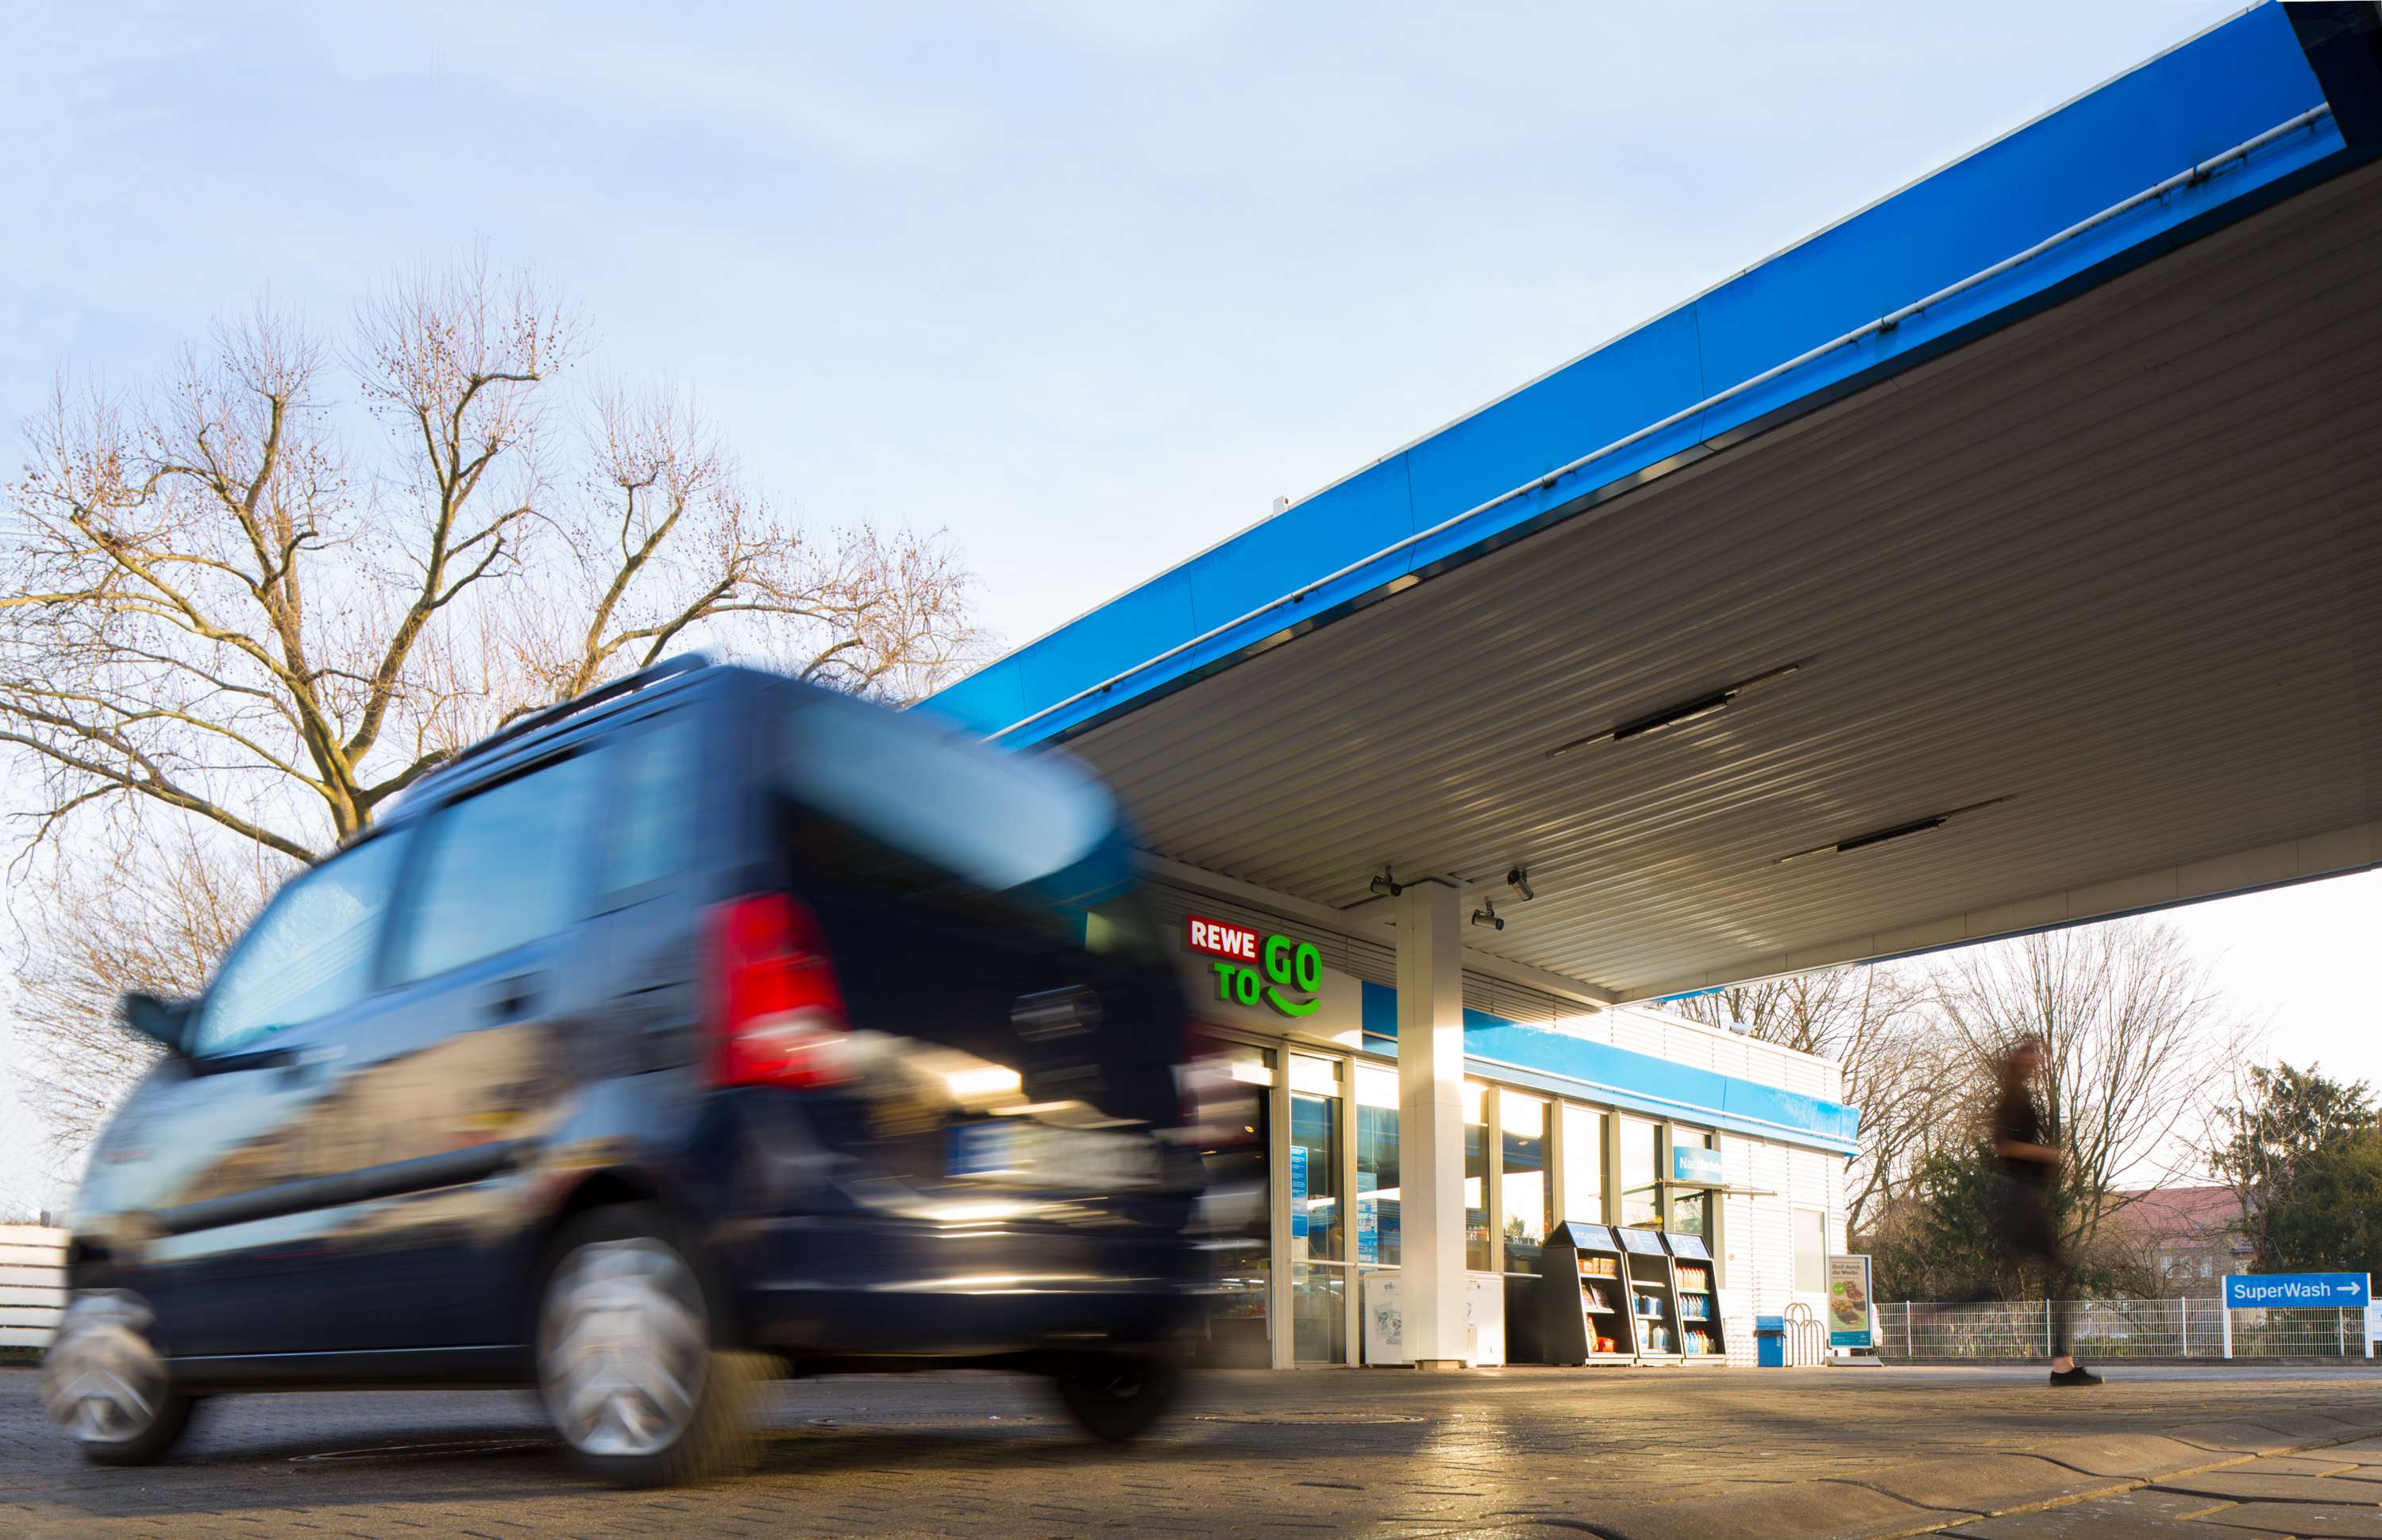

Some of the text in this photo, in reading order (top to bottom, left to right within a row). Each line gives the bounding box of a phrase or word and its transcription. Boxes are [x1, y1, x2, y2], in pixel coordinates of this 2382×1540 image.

[1191, 920, 1256, 959] REWE
[1212, 934, 1322, 1007] TO GO
[2234, 1282, 2331, 1301] SuperWash
